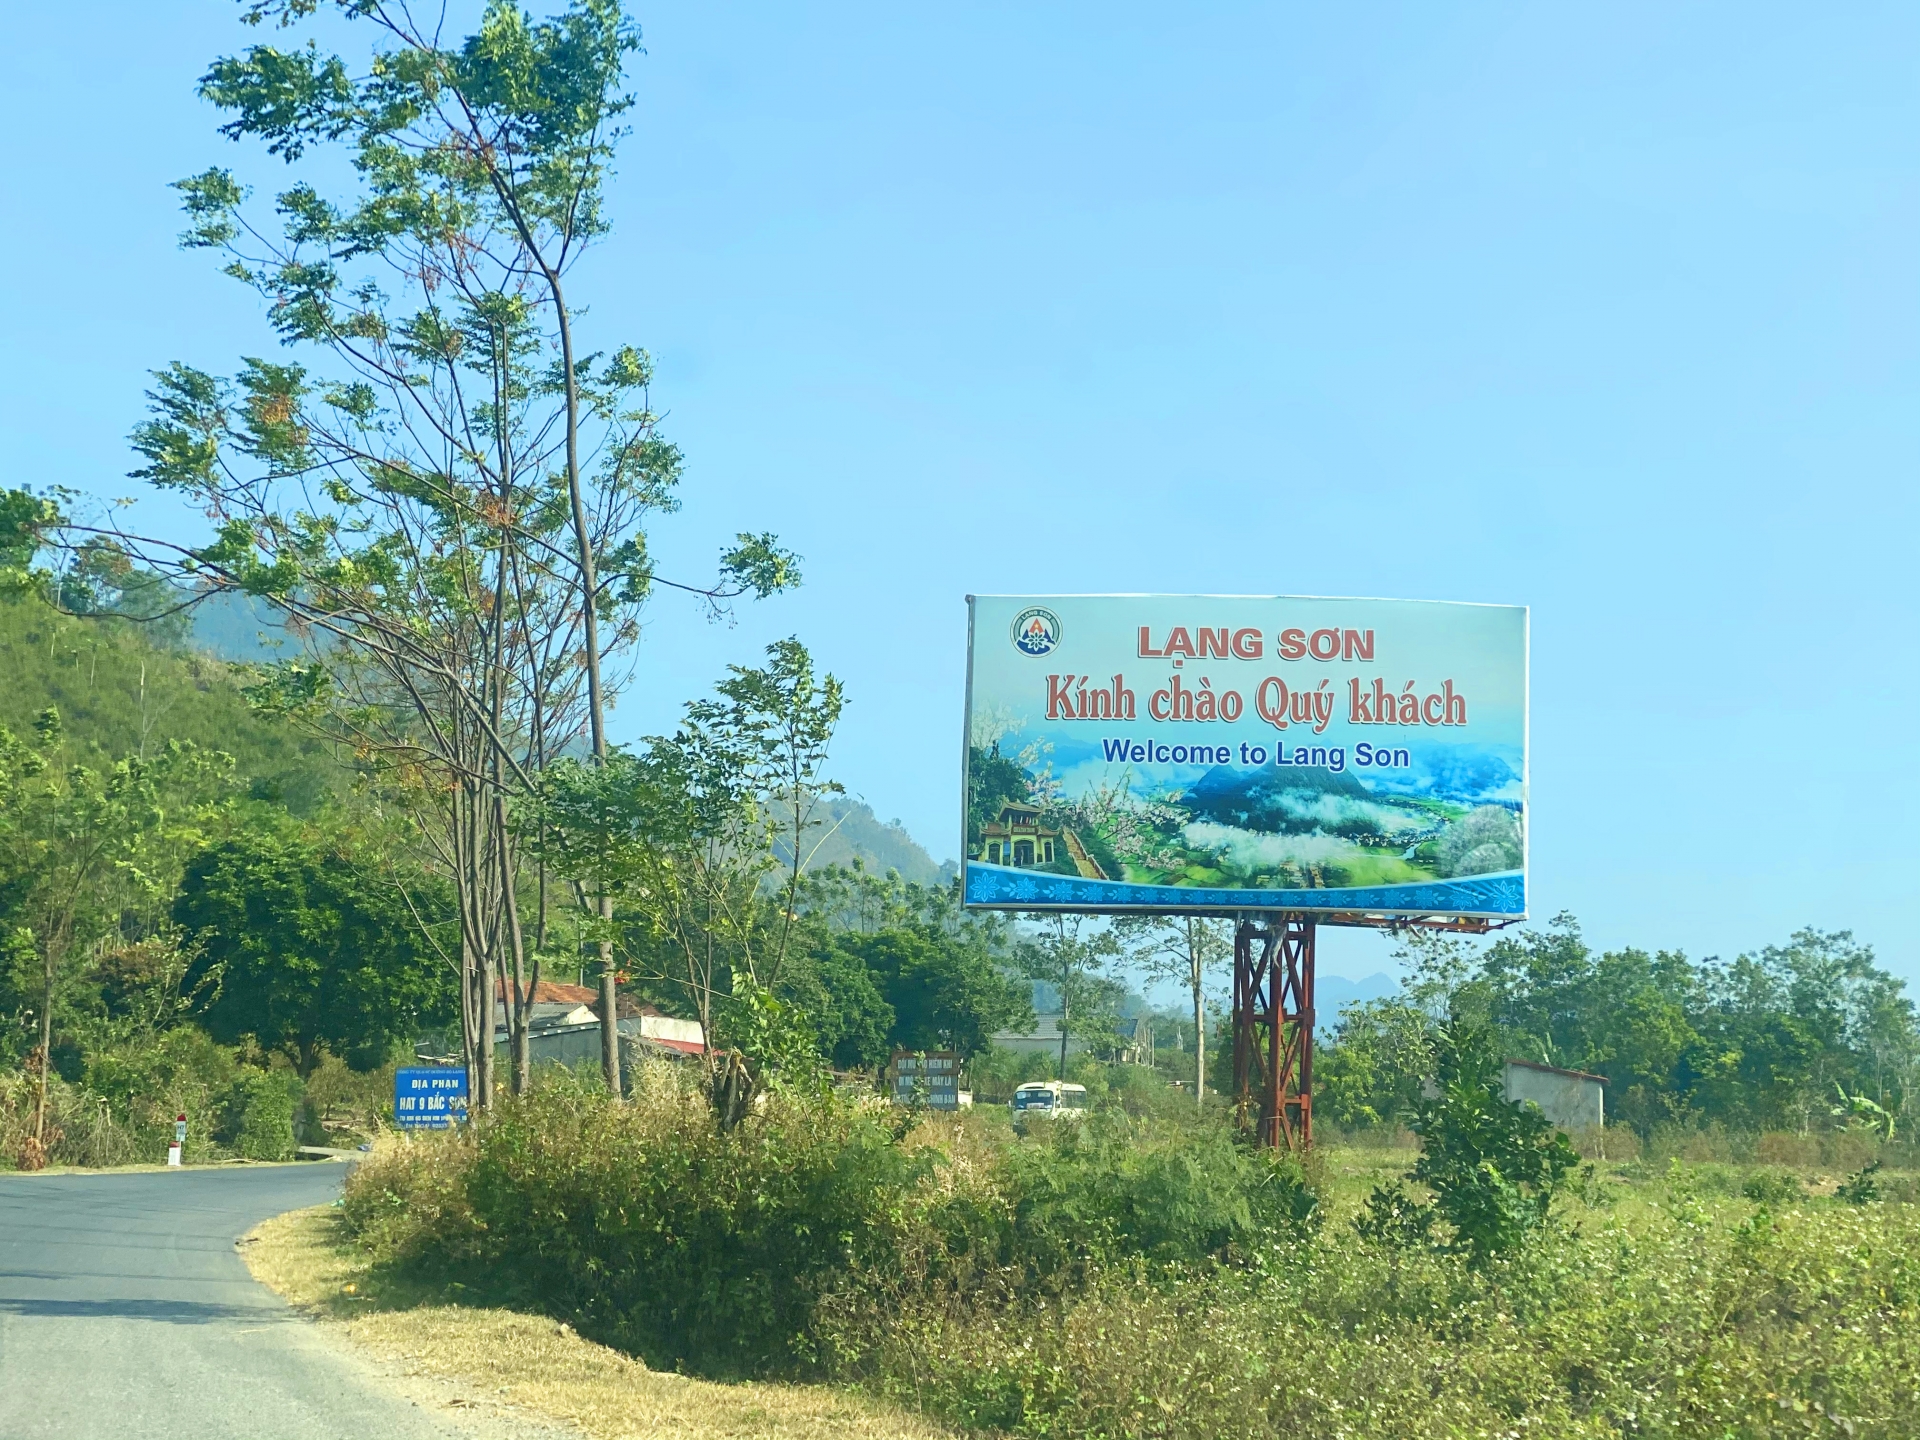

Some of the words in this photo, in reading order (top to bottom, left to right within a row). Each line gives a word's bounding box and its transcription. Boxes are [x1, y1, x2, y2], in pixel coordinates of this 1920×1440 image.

[1138, 626, 1263, 668] LẠNG
[1278, 627, 1375, 662] SƠN
[1046, 673, 1137, 720] Kính
[1149, 674, 1244, 722] chào
[1256, 676, 1335, 734] Quý
[1348, 677, 1468, 726] khách
[1102, 738, 1231, 765] Welcome
[1240, 741, 1267, 765] to
[1276, 741, 1346, 772] Lang
[1354, 742, 1410, 767] Son
[411, 1079, 428, 1090] ĐỊA
[432, 1079, 459, 1090] PHẠN
[419, 1097, 425, 1110] 9
[427, 1091, 445, 1110] BẮC
